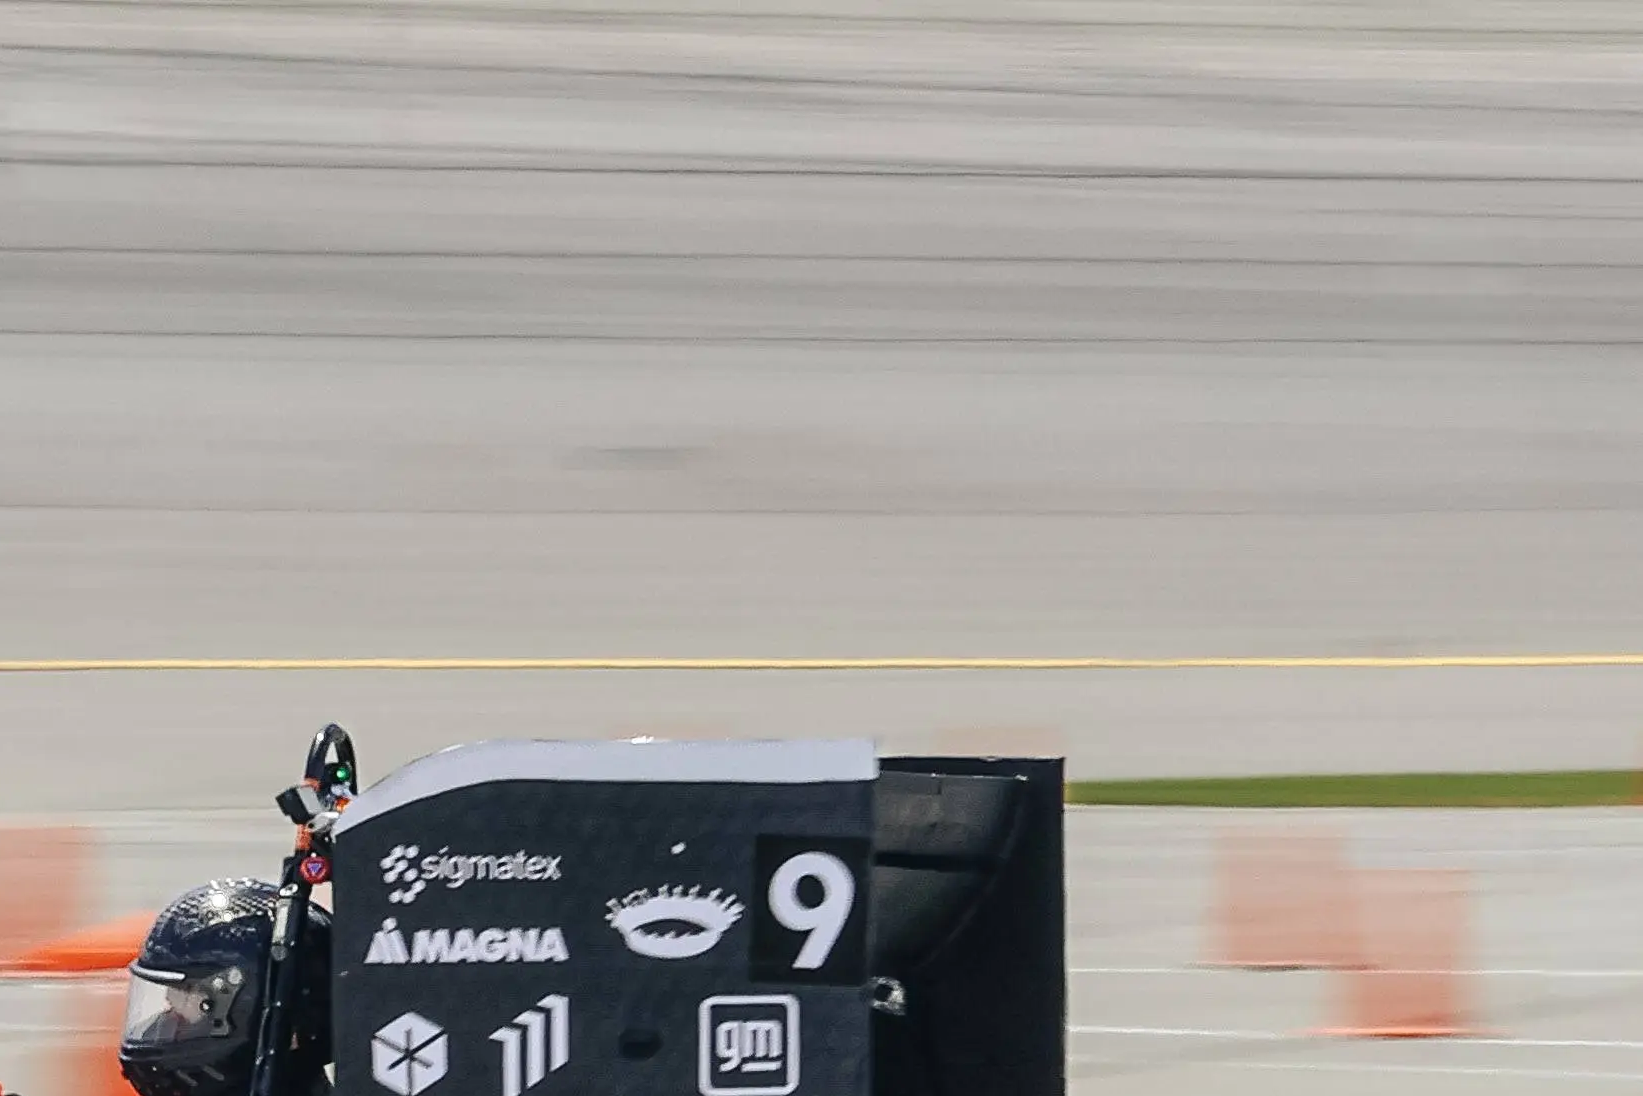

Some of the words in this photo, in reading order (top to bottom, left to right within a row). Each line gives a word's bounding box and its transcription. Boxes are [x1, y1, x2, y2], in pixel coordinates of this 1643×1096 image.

[420, 845, 562, 888] sigmatex
[768, 851, 856, 970] 9
[411, 928, 569, 964] MAGNA
[715, 1020, 783, 1073] gm
